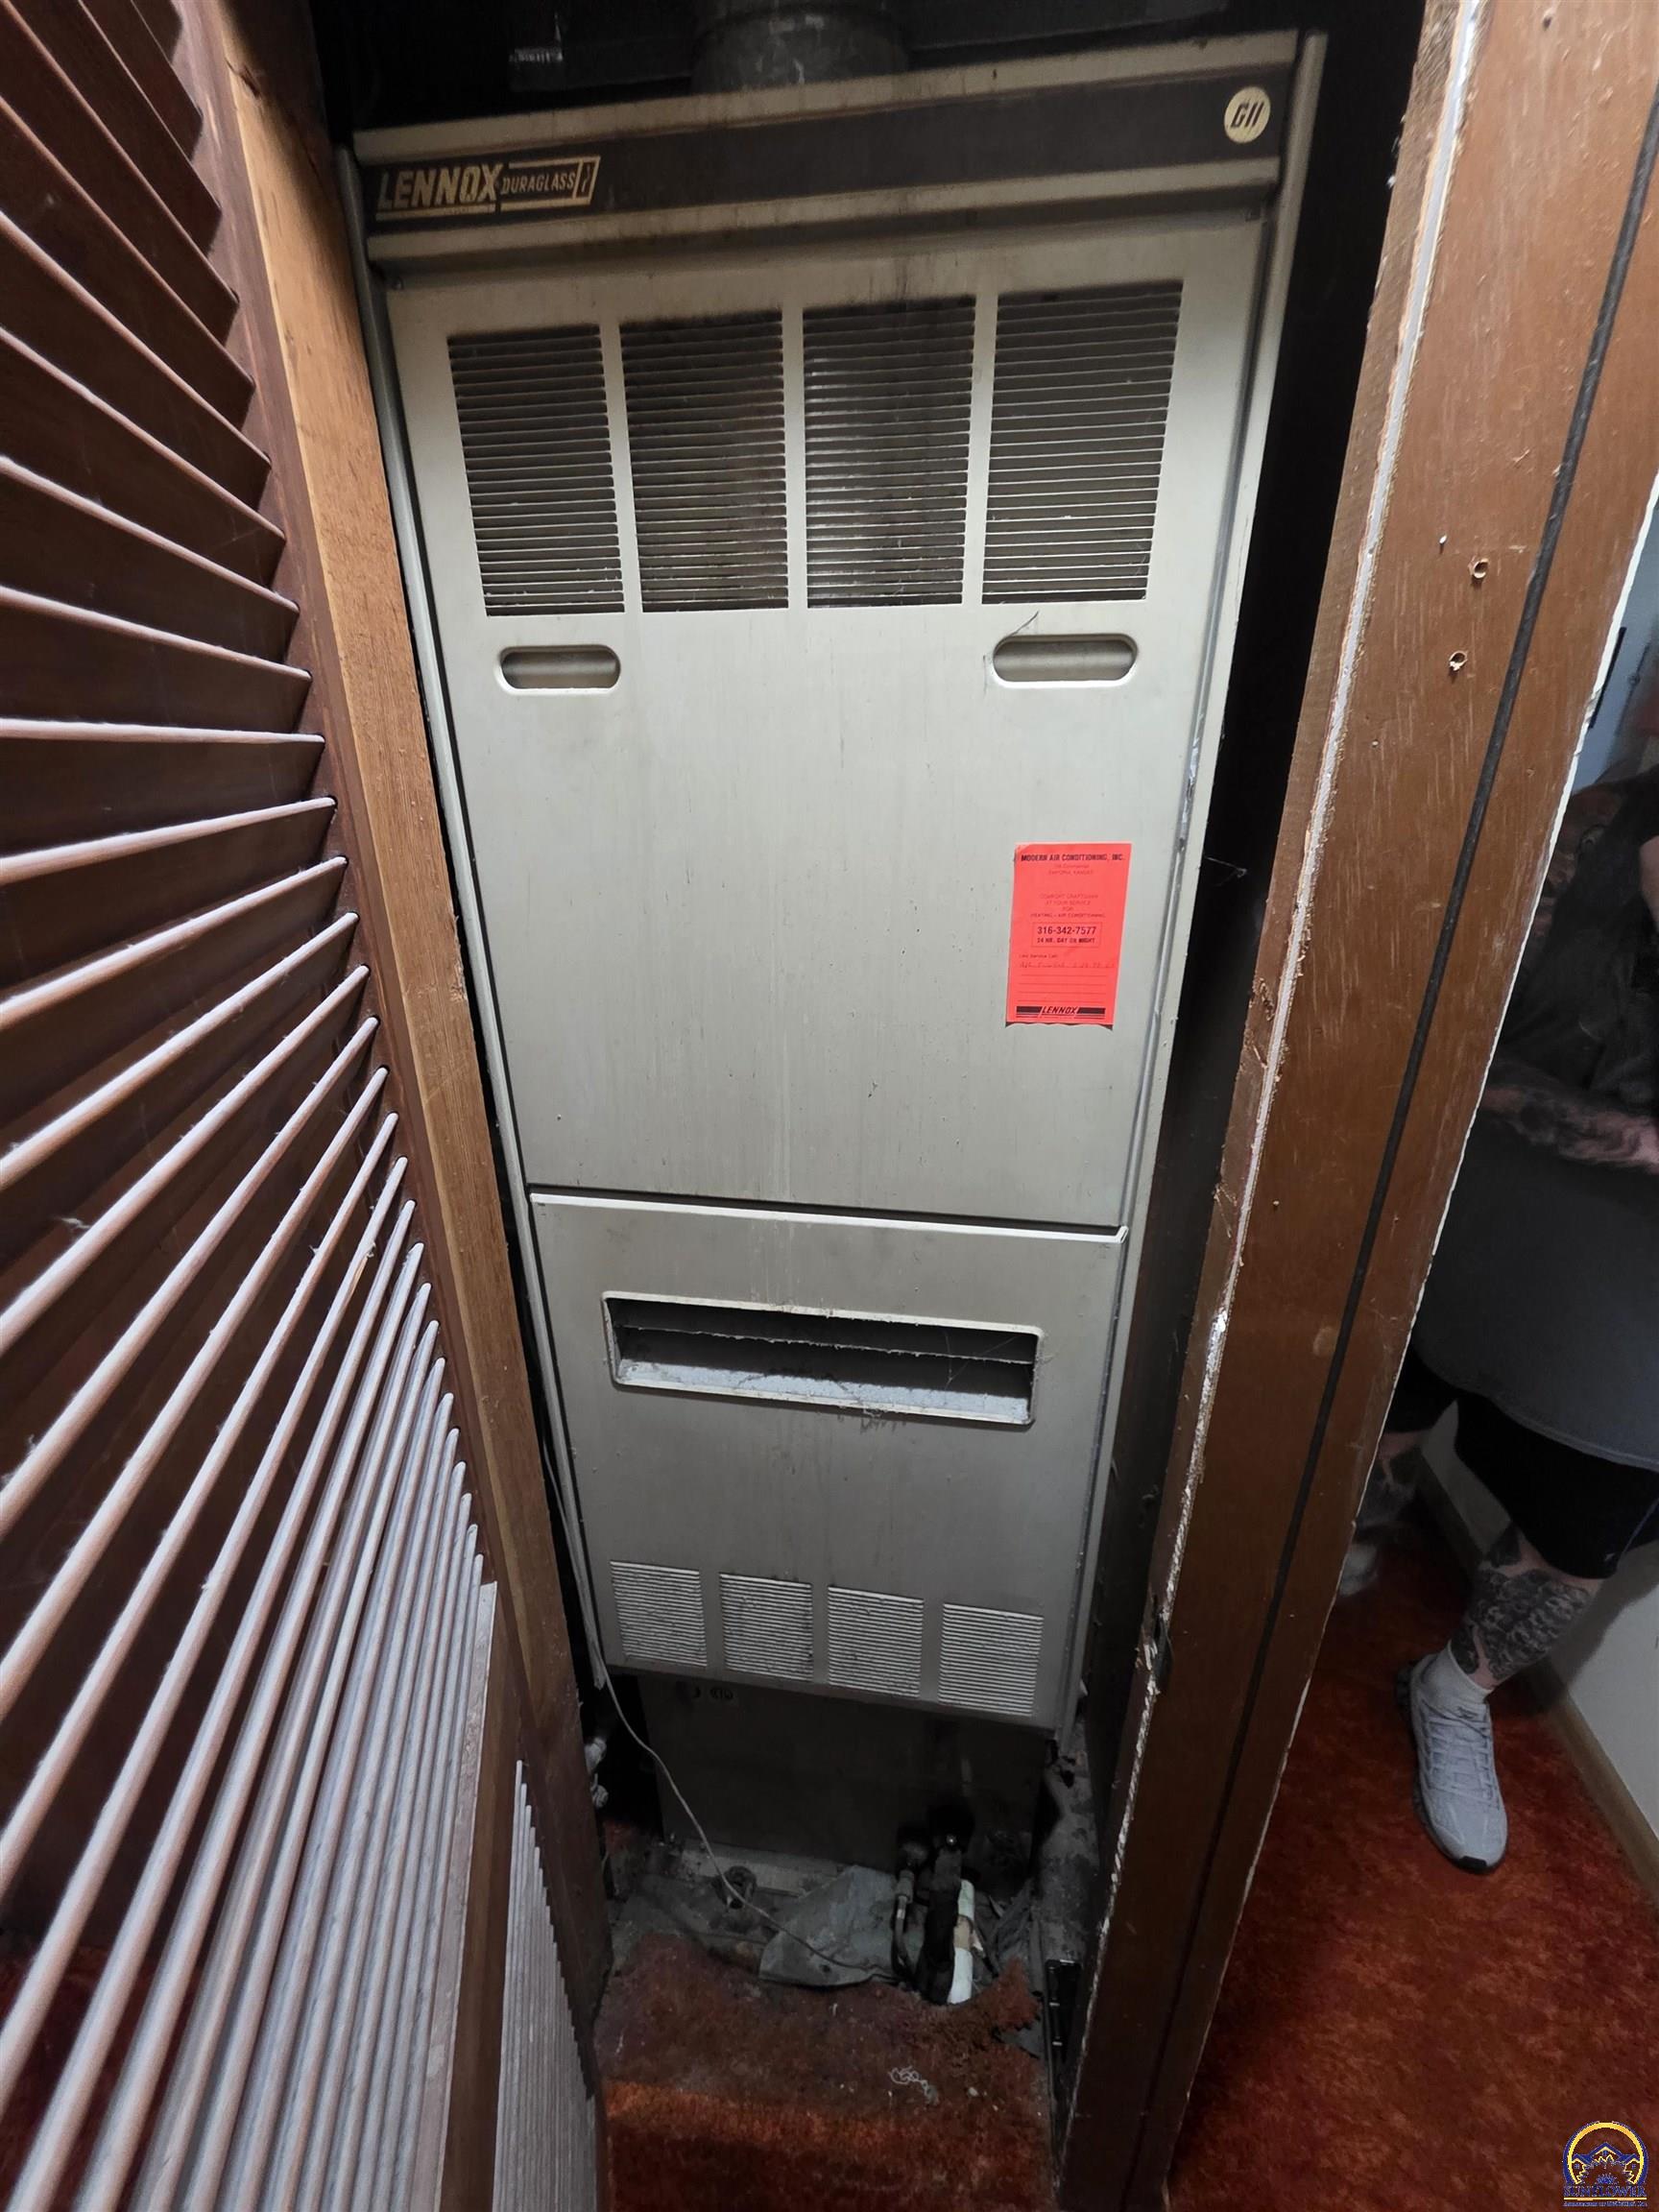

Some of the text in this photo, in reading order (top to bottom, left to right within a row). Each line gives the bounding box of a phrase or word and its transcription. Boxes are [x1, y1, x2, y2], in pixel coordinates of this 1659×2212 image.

[377, 163, 576, 209] LENNOX DURAGLASS
[1022, 854, 1048, 862] MODERN
[1037, 926, 1096, 935] 316-342-7577
[1042, 1006, 1078, 1015] LENNOX
